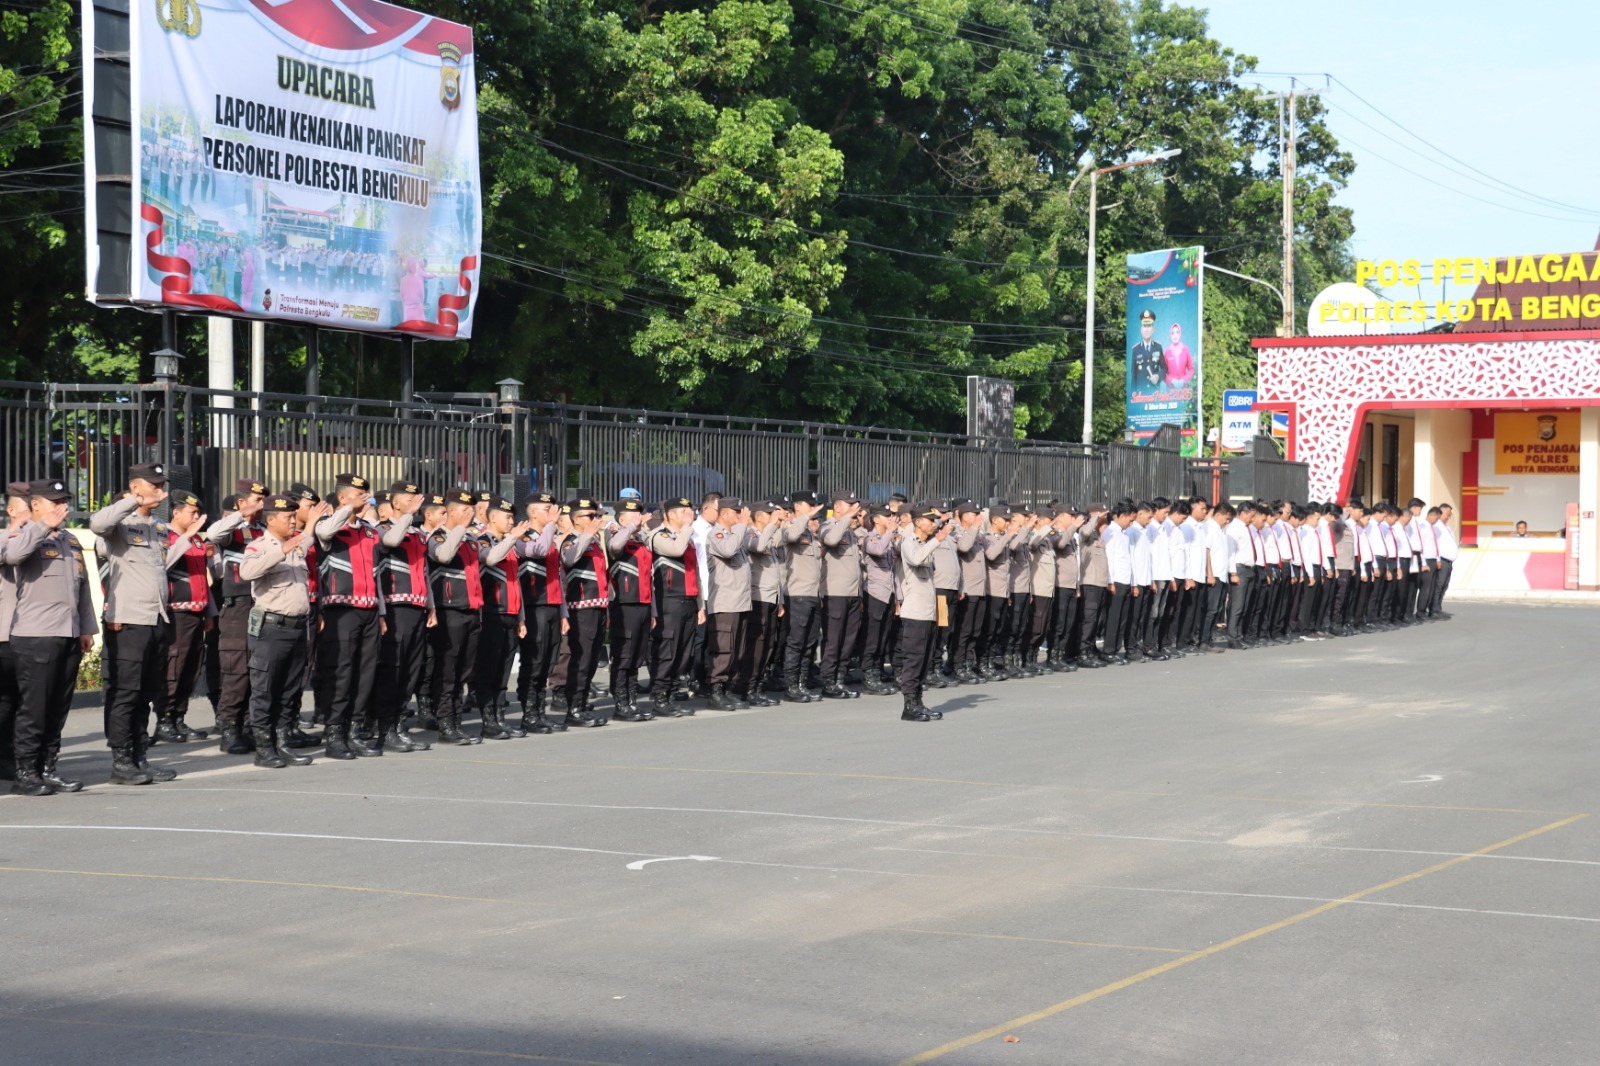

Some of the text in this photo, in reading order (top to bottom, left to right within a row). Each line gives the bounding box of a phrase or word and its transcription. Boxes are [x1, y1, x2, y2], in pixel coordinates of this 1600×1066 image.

[277, 54, 376, 110] UPACARA
[215, 94, 426, 166] LAPORAN KENAIKAN PANGKAT
[202, 137, 429, 208] PERSONEL POLRESTA BENGKULU
[1356, 258, 1421, 288] POS
[280, 293, 339, 310] Transformasi Menuju
[1320, 293, 1600, 324] POLRES KOTA BENG
[279, 304, 331, 318] Polresta Bengkulu
[1229, 421, 1252, 429] ATM
[1503, 444, 1524, 453] POS
[1525, 455, 1569, 463] POLRES
[1511, 465, 1535, 473] KOTA
